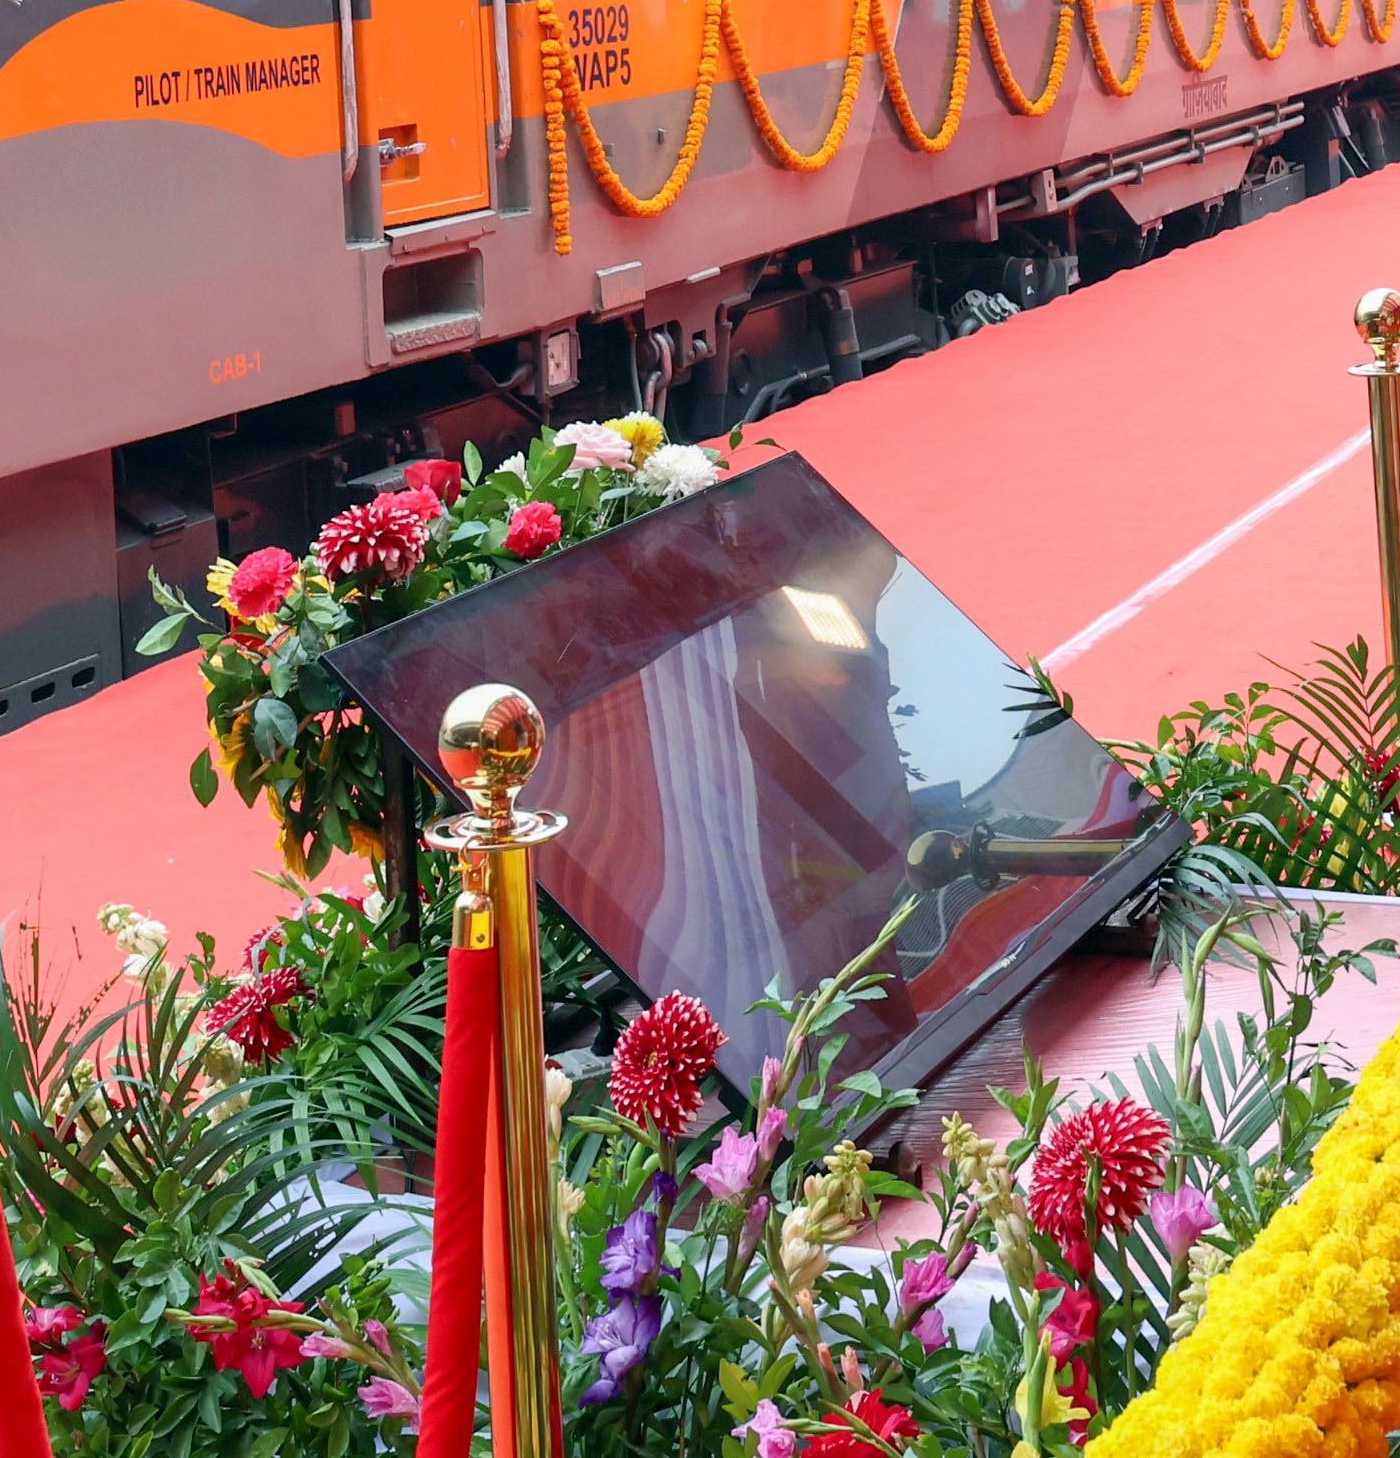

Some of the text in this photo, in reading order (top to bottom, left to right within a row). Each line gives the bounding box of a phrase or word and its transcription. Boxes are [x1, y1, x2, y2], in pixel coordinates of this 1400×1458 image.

[568, 4, 630, 48] 35029
[134, 53, 321, 109] PILOT / TRAIN MANAGER
[208, 349, 263, 384] CAB-1
